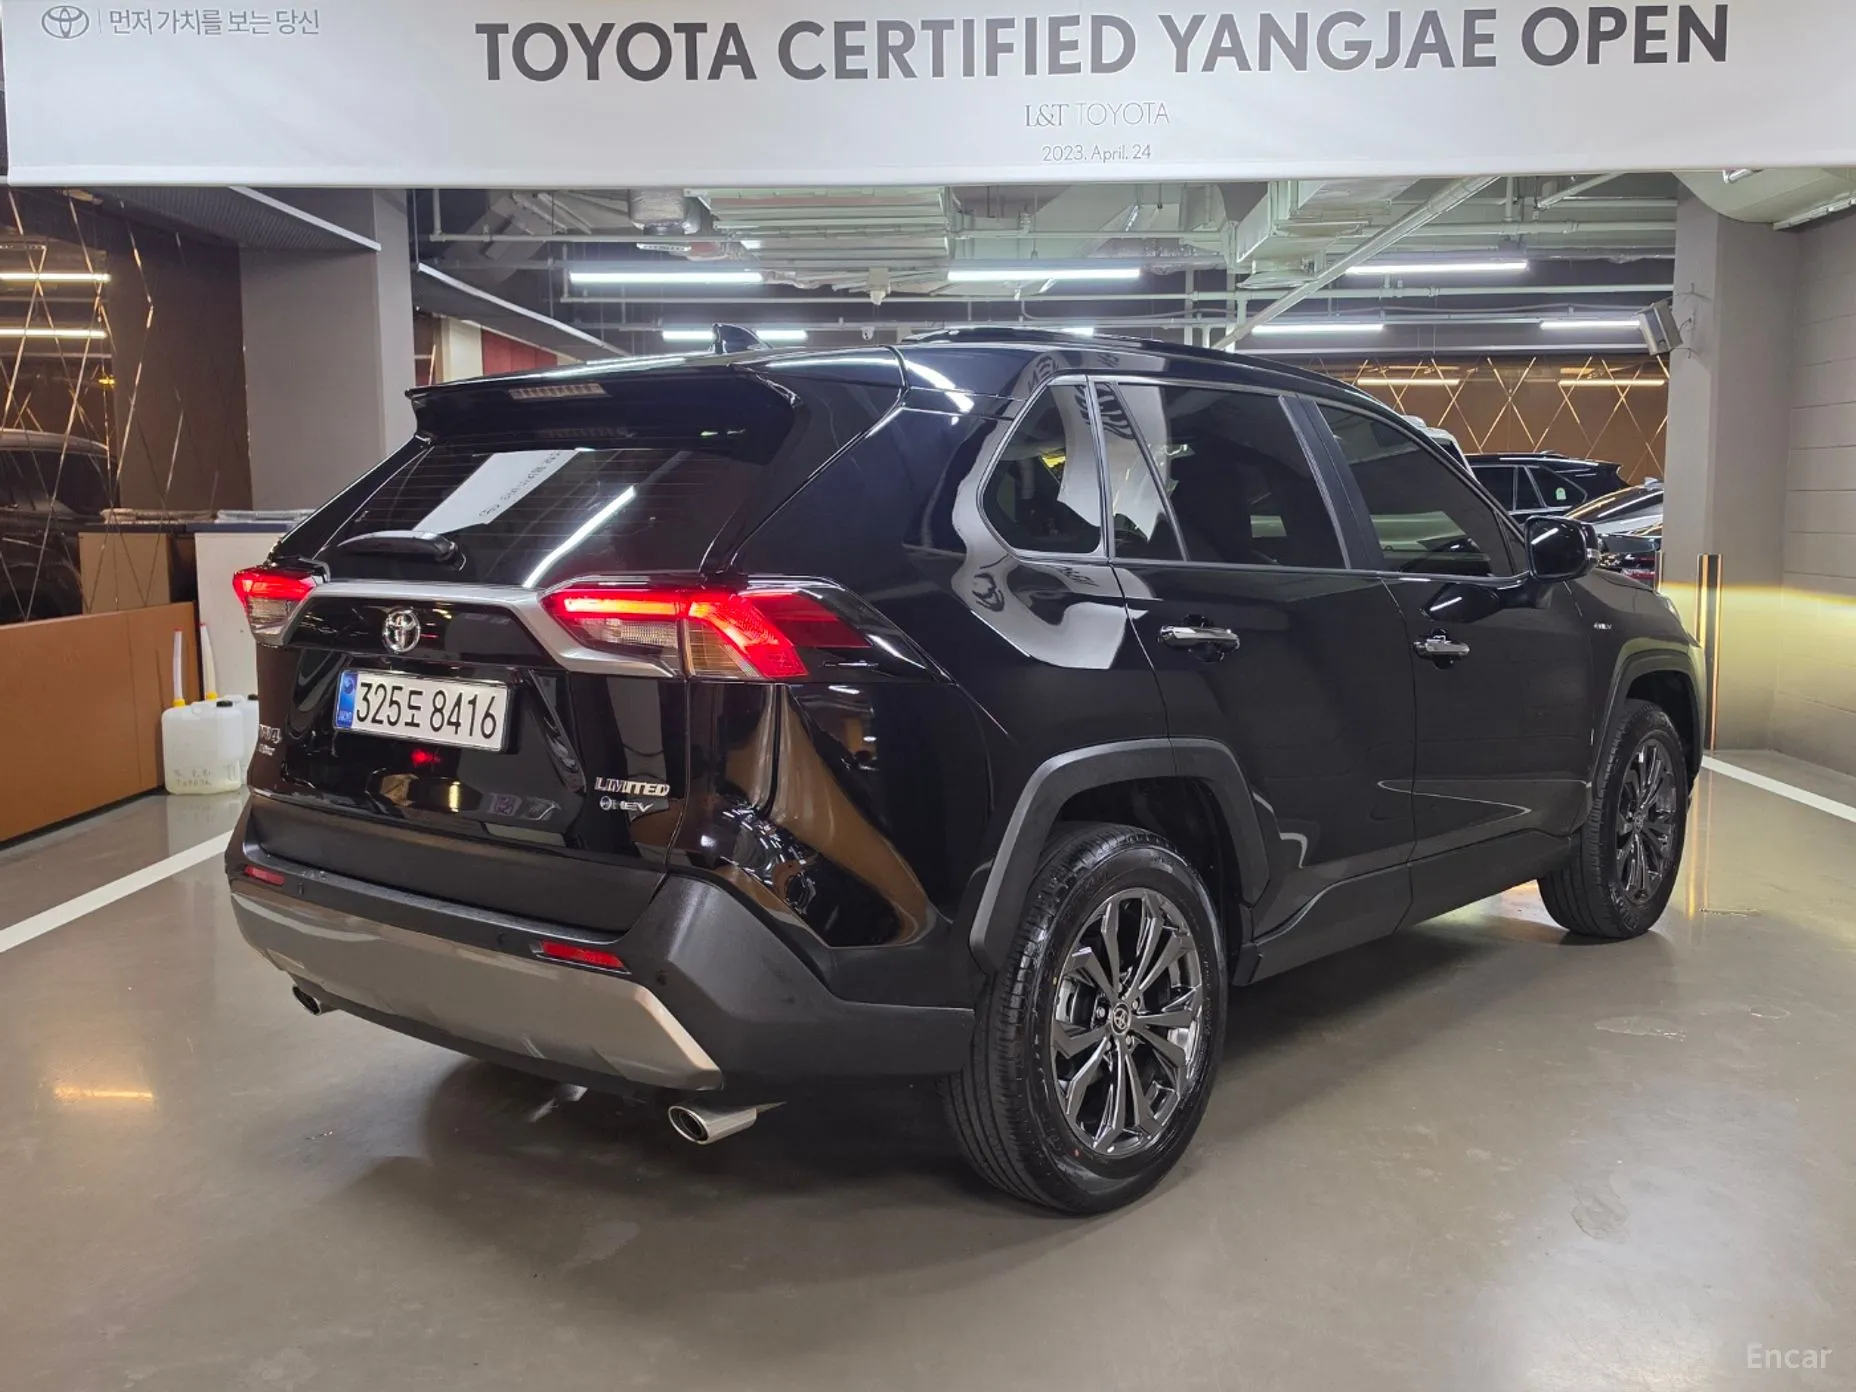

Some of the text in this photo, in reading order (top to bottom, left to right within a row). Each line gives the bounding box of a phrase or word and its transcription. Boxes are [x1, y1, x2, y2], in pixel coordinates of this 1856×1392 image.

[109, 8, 320, 35] 먼저 가치를 보는 당신
[475, 4, 1729, 82] TOYOTA CERTIFIED YANGJAE OPEN
[1074, 102, 1170, 126] TOYOTA
[1042, 145, 1087, 162] 2023.
[1132, 144, 1152, 160] 24
[356, 682, 497, 740] 325도 8416
[594, 776, 670, 797] LIMITED
